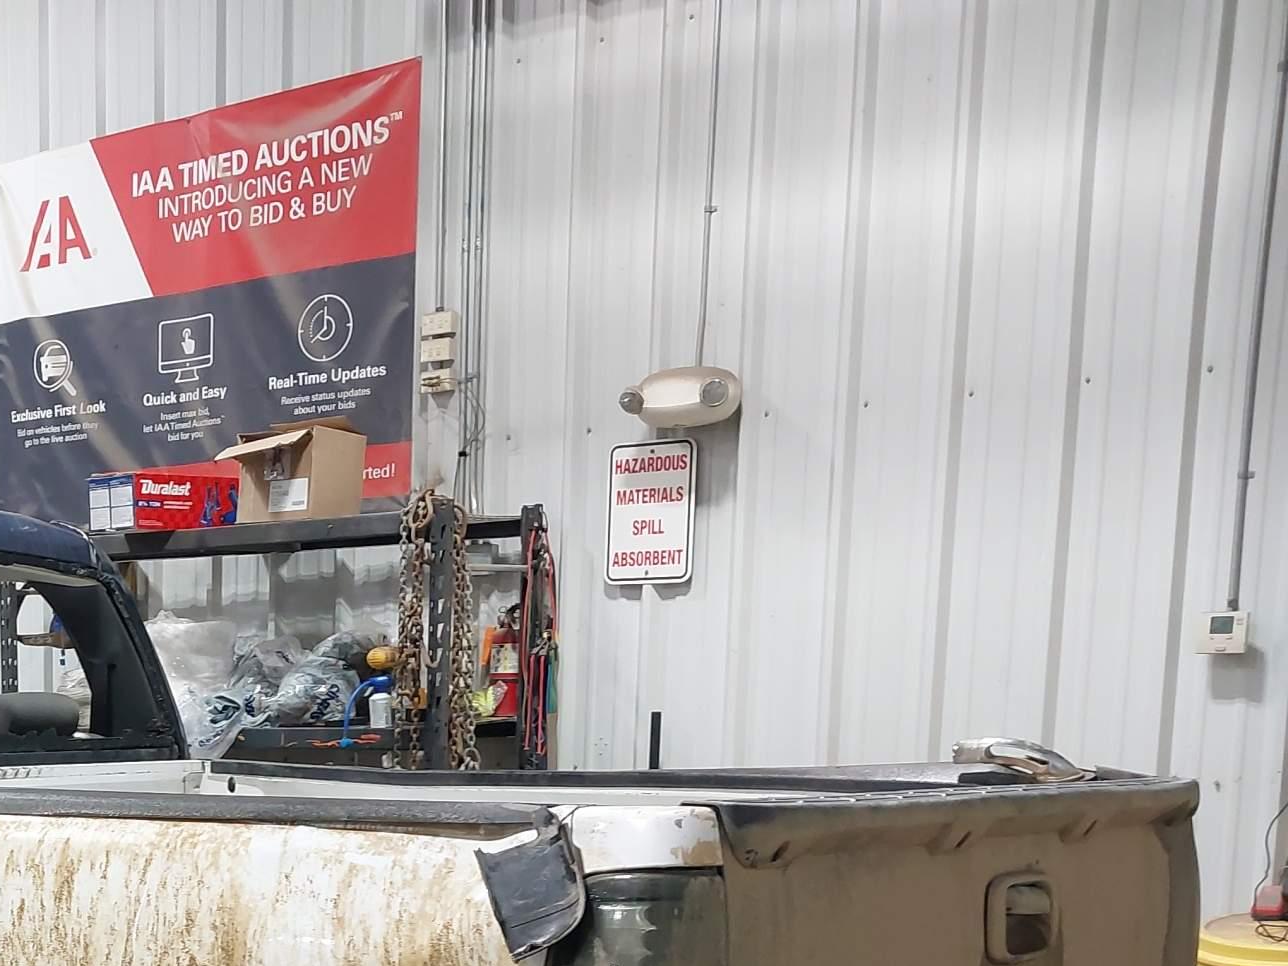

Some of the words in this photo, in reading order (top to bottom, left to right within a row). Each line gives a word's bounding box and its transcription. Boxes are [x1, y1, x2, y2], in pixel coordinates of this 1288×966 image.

[131, 167, 174, 198] IAA
[178, 149, 249, 187] TIMED
[158, 171, 292, 219] INTRODUCING
[298, 167, 314, 191] A
[320, 153, 373, 186] NEW
[172, 214, 212, 243] WAY
[218, 208, 242, 233] TO
[249, 202, 283, 227] BID
[288, 196, 306, 220] &
[311, 185, 357, 216] BUY
[268, 372, 328, 390] Real-Time
[331, 365, 387, 383] Updates
[143, 391, 177, 406] Quick
[179, 387, 200, 402] and
[201, 386, 227, 399] Easy
[280, 394, 310, 405] Receive
[311, 391, 336, 402] status
[337, 387, 371, 399] updates
[10, 407, 53, 423] Exclusive
[54, 404, 76, 417] First
[79, 400, 106, 415] Look
[293, 404, 315, 415] about
[317, 402, 336, 414] your
[337, 400, 357, 410] bids
[362, 463, 396, 480] rted!
[615, 454, 687, 474] HAZARDOUS
[139, 479, 192, 496] Duralast
[616, 486, 684, 506] MATERIALS
[632, 519, 664, 536] SPILL
[612, 549, 683, 567] ABSORBENT
